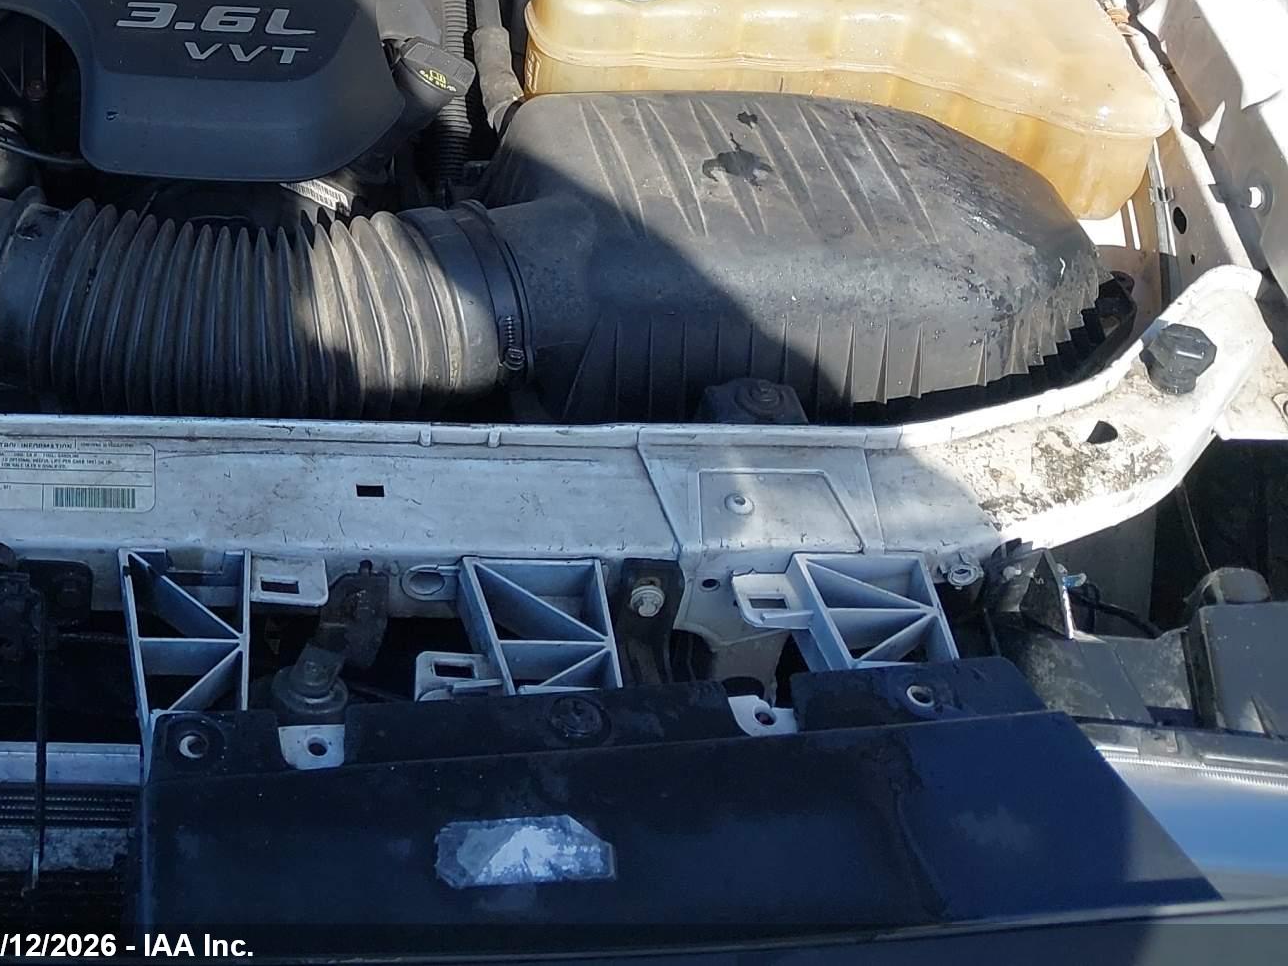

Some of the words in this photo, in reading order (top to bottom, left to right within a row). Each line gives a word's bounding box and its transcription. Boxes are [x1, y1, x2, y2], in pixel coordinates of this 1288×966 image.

[116, 1, 316, 35] 3.6L
[184, 41, 309, 64] VVT
[20, 441, 72, 450] INFORMATION
